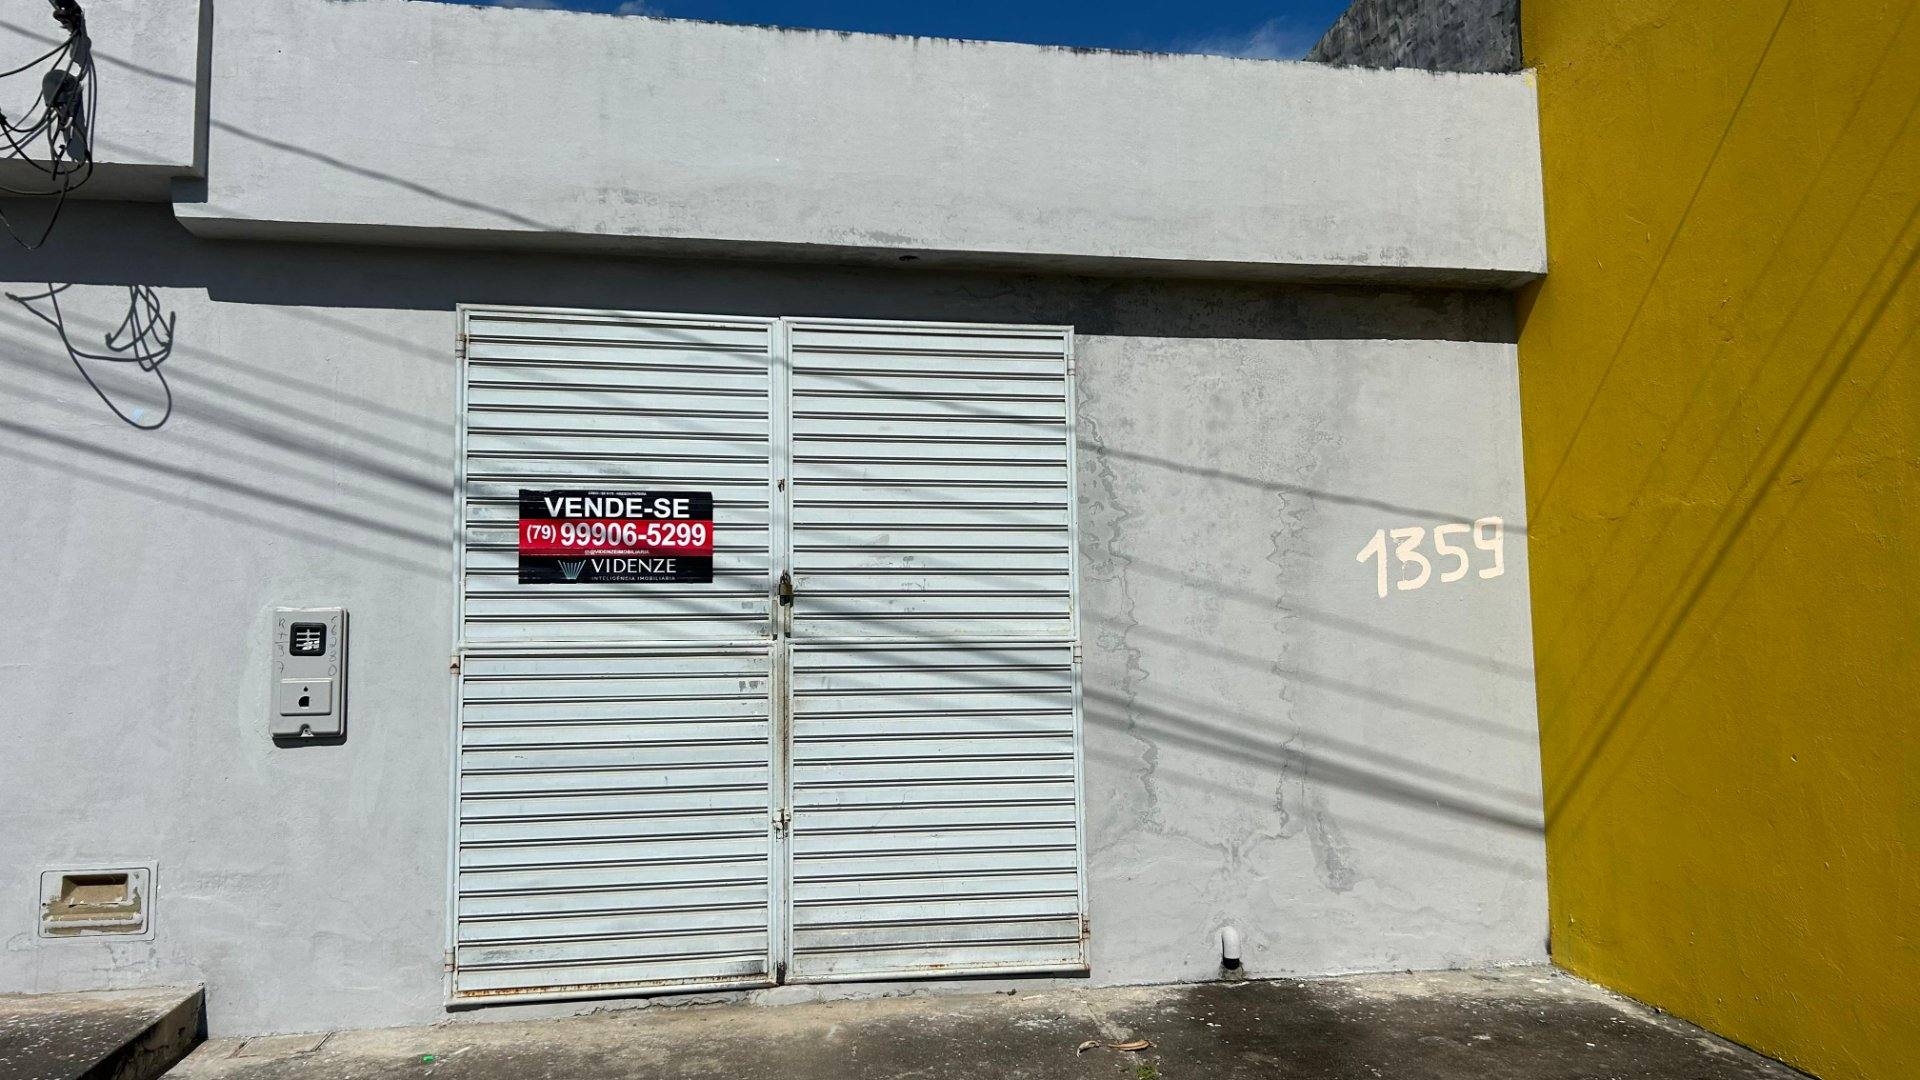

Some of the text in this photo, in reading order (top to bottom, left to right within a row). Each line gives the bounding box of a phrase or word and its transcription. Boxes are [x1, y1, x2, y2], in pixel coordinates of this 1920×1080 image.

[544, 497, 690, 518] VENDE-SE
[526, 522, 706, 546] (79) 99906-5299
[591, 558, 677, 573] VIDENZE
[1356, 516, 1504, 598] 1359
